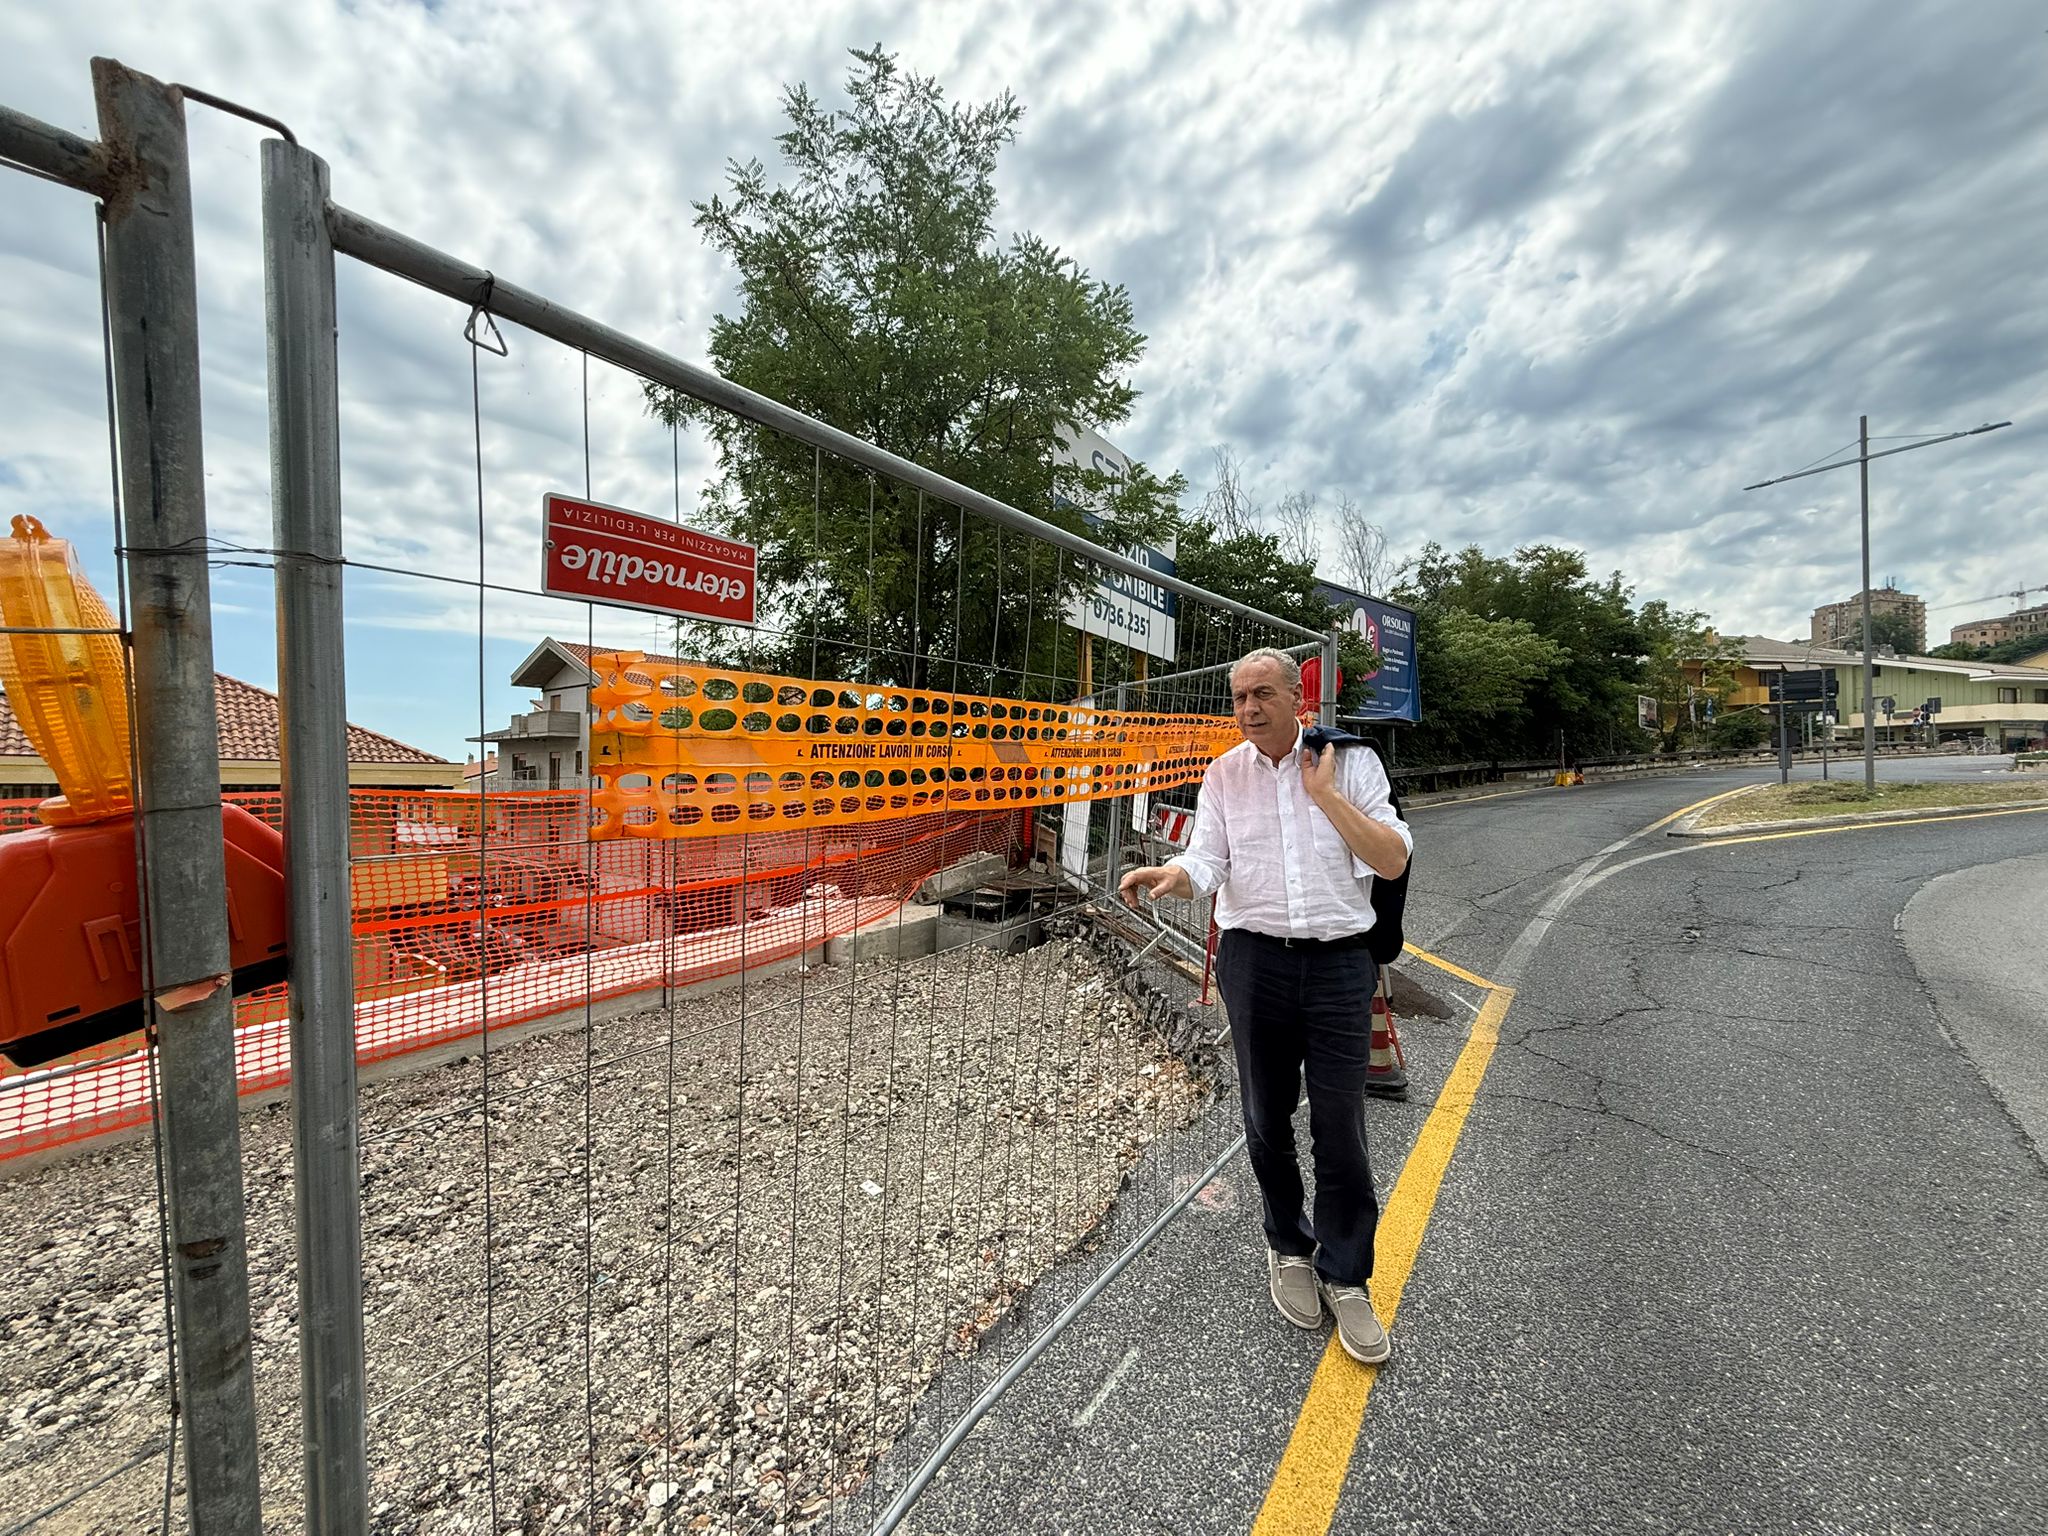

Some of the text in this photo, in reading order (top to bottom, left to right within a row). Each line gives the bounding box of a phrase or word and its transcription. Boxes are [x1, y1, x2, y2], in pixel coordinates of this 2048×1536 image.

[562, 507, 747, 561] MAGAZZINI PER L'EDILIZIA
[561, 544, 746, 602] eternedile
[1381, 614, 1411, 633] ORSOLINI
[810, 743, 953, 759] ATTENZIONE LAVORI IN CORSO
[1050, 747, 1083, 758] ATTENZIONE
